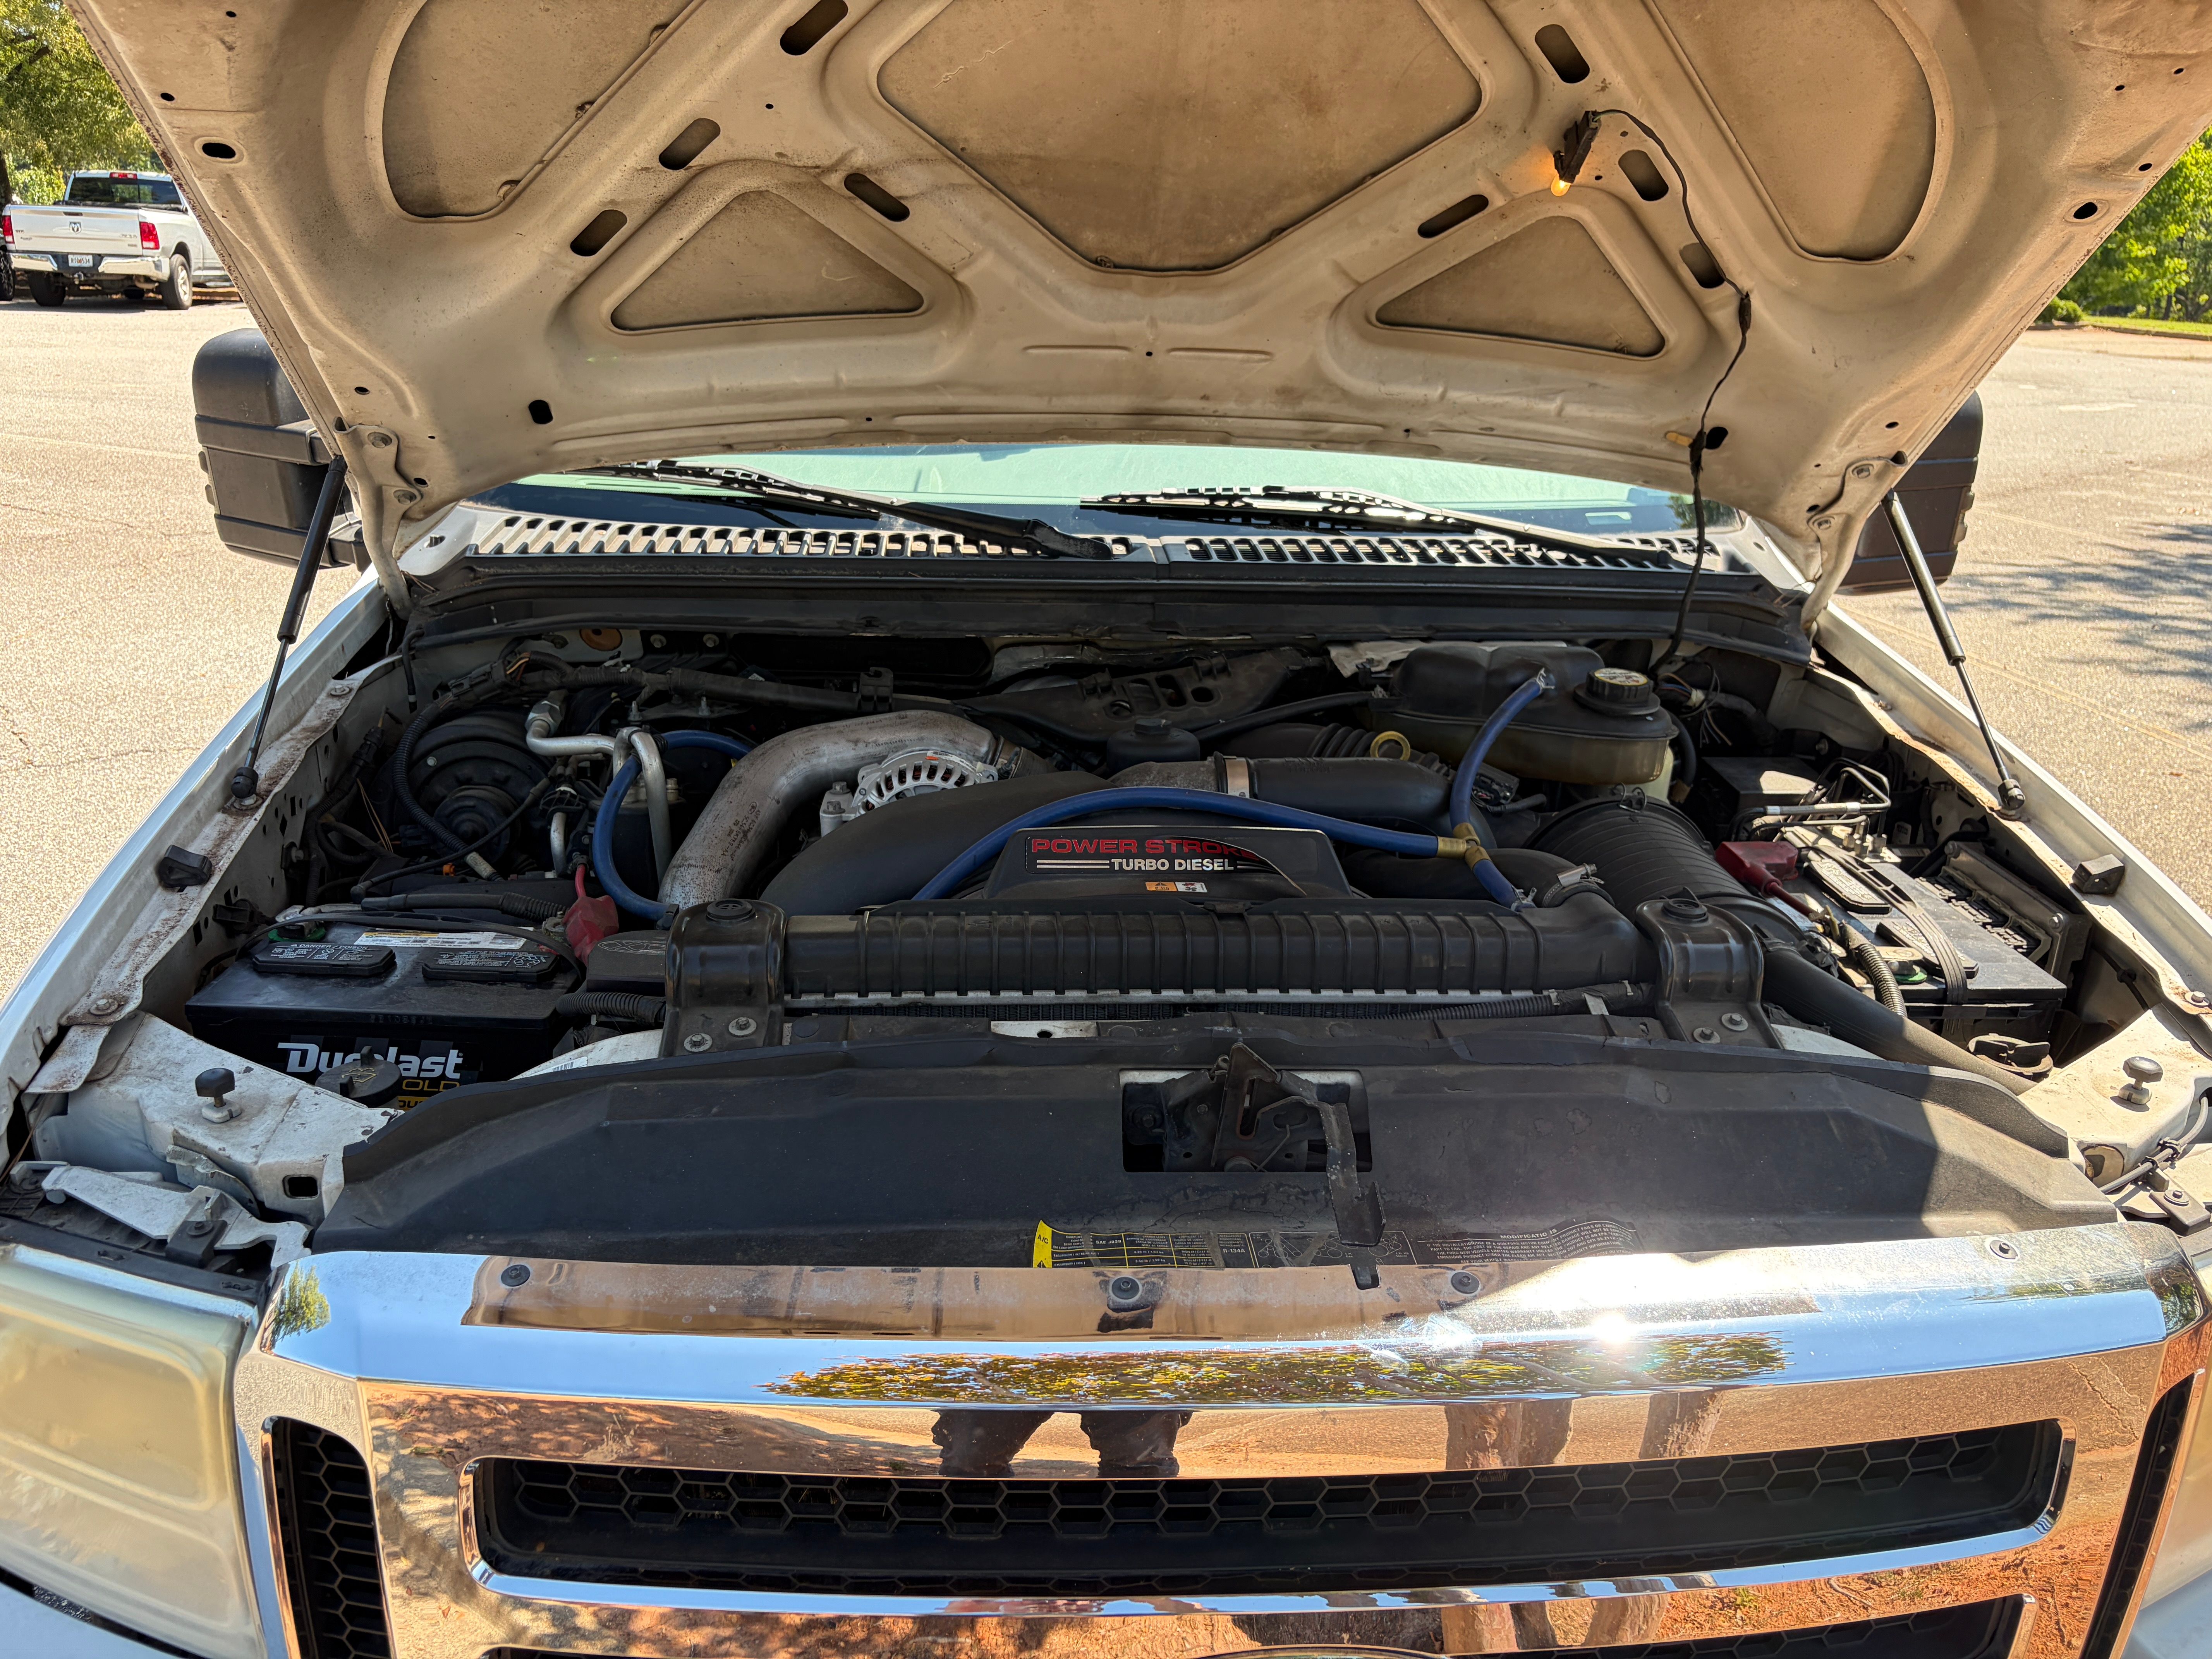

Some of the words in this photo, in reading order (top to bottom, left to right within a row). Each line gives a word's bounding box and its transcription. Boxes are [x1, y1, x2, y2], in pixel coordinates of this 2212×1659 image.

[1032, 839, 1138, 854] POWER
[1111, 859, 1170, 871] TURBO
[1175, 859, 1234, 871] DIESEL
[1560, 1228, 1580, 1239] PRODUCT
[1562, 1233, 1580, 1243] DAMAGE
[1037, 1235, 1049, 1244] A/C
[1563, 1247, 1588, 1259] WARRANTY
